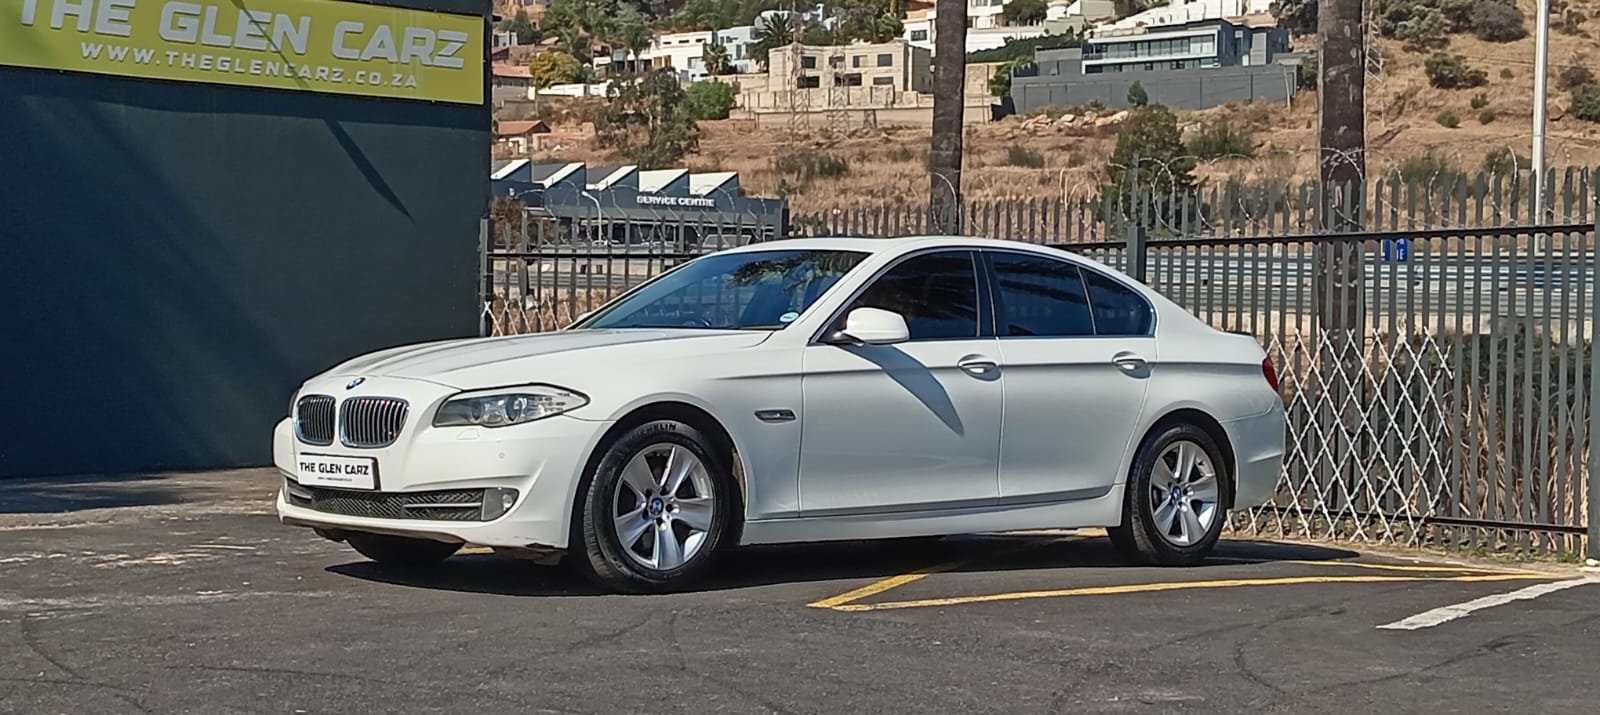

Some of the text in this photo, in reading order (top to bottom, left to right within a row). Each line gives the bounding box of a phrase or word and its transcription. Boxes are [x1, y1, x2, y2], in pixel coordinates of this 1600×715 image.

[159, 1, 311, 54] GLEN
[332, 20, 468, 69] CARZ
[80, 42, 417, 89] WWW.THEGLENCARZ.CO.ZA
[636, 195, 715, 207] SERVICE CENTRE
[299, 462, 369, 476] THE GLEN CARZ
